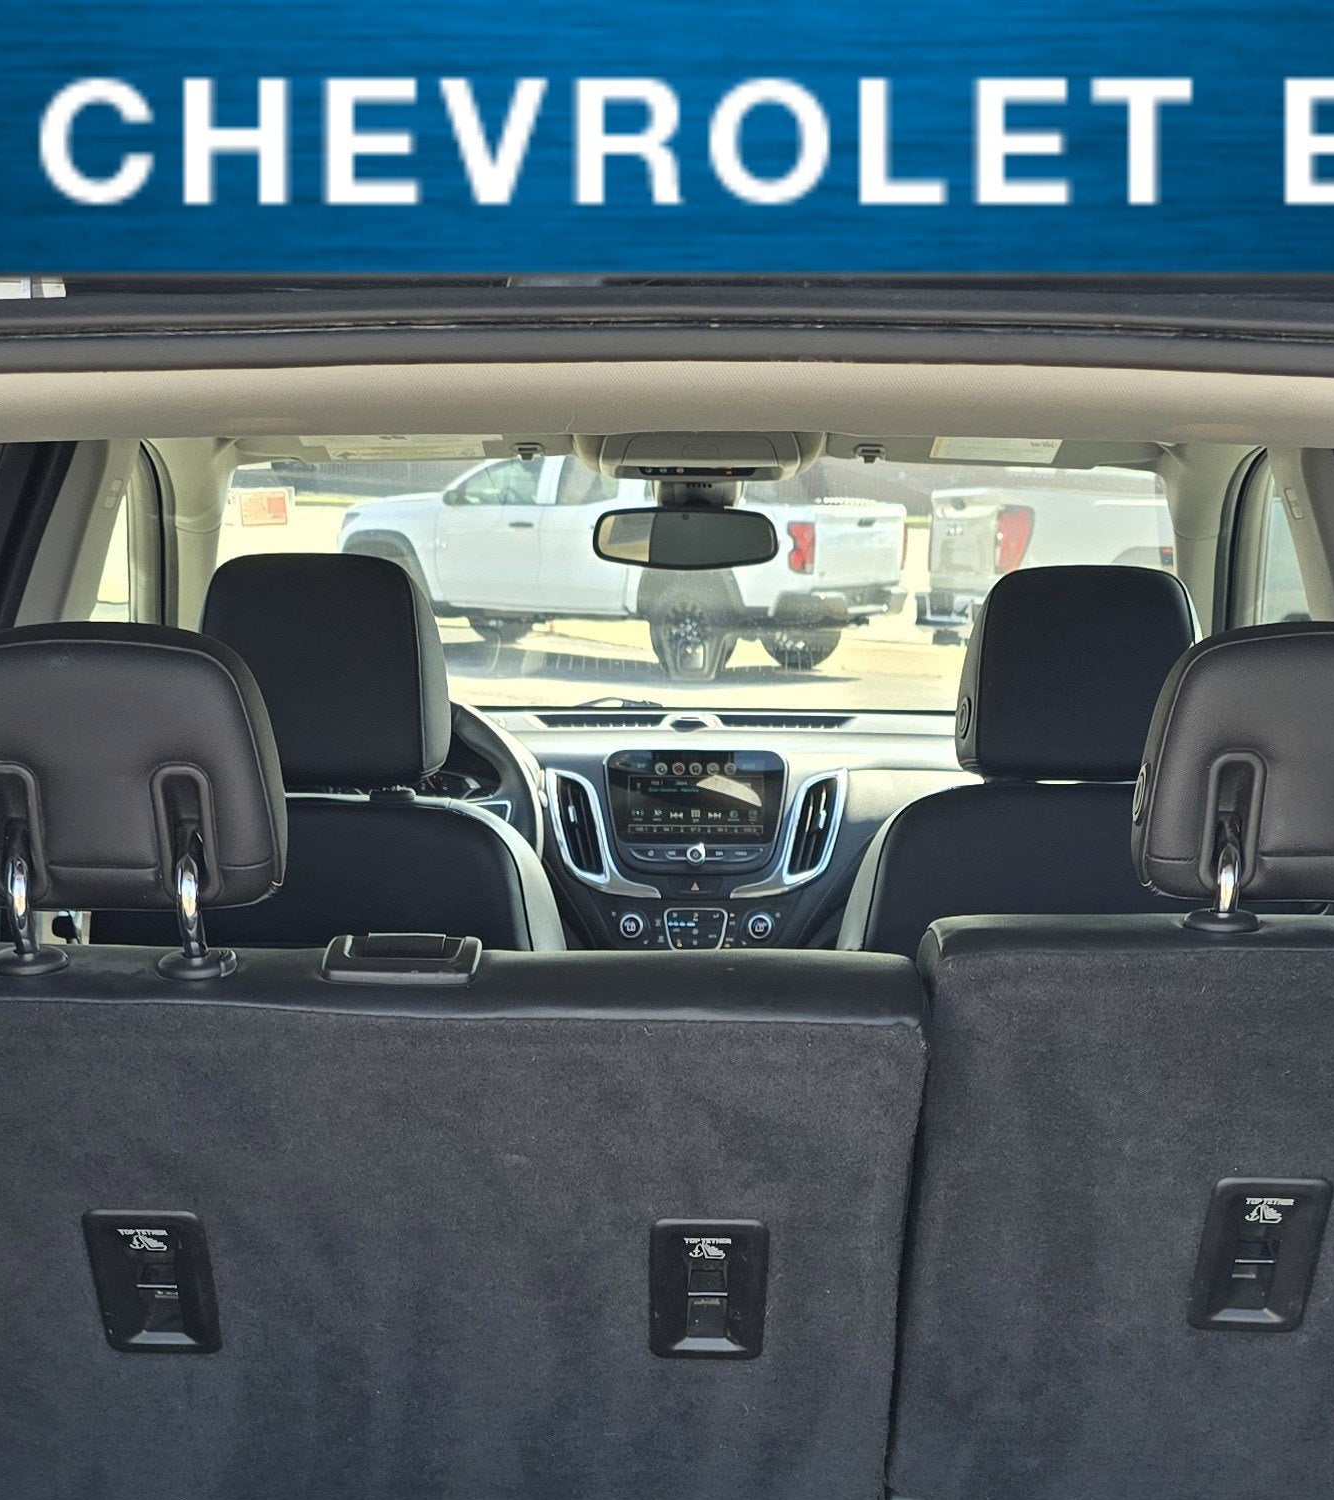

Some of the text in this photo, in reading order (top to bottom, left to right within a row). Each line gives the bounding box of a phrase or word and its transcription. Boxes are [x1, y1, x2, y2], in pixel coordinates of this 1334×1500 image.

[1246, 1197, 1295, 1206] TOP TETHER
[117, 1228, 168, 1236] TOP TETHER
[701, 1237, 732, 1245] TETHER
